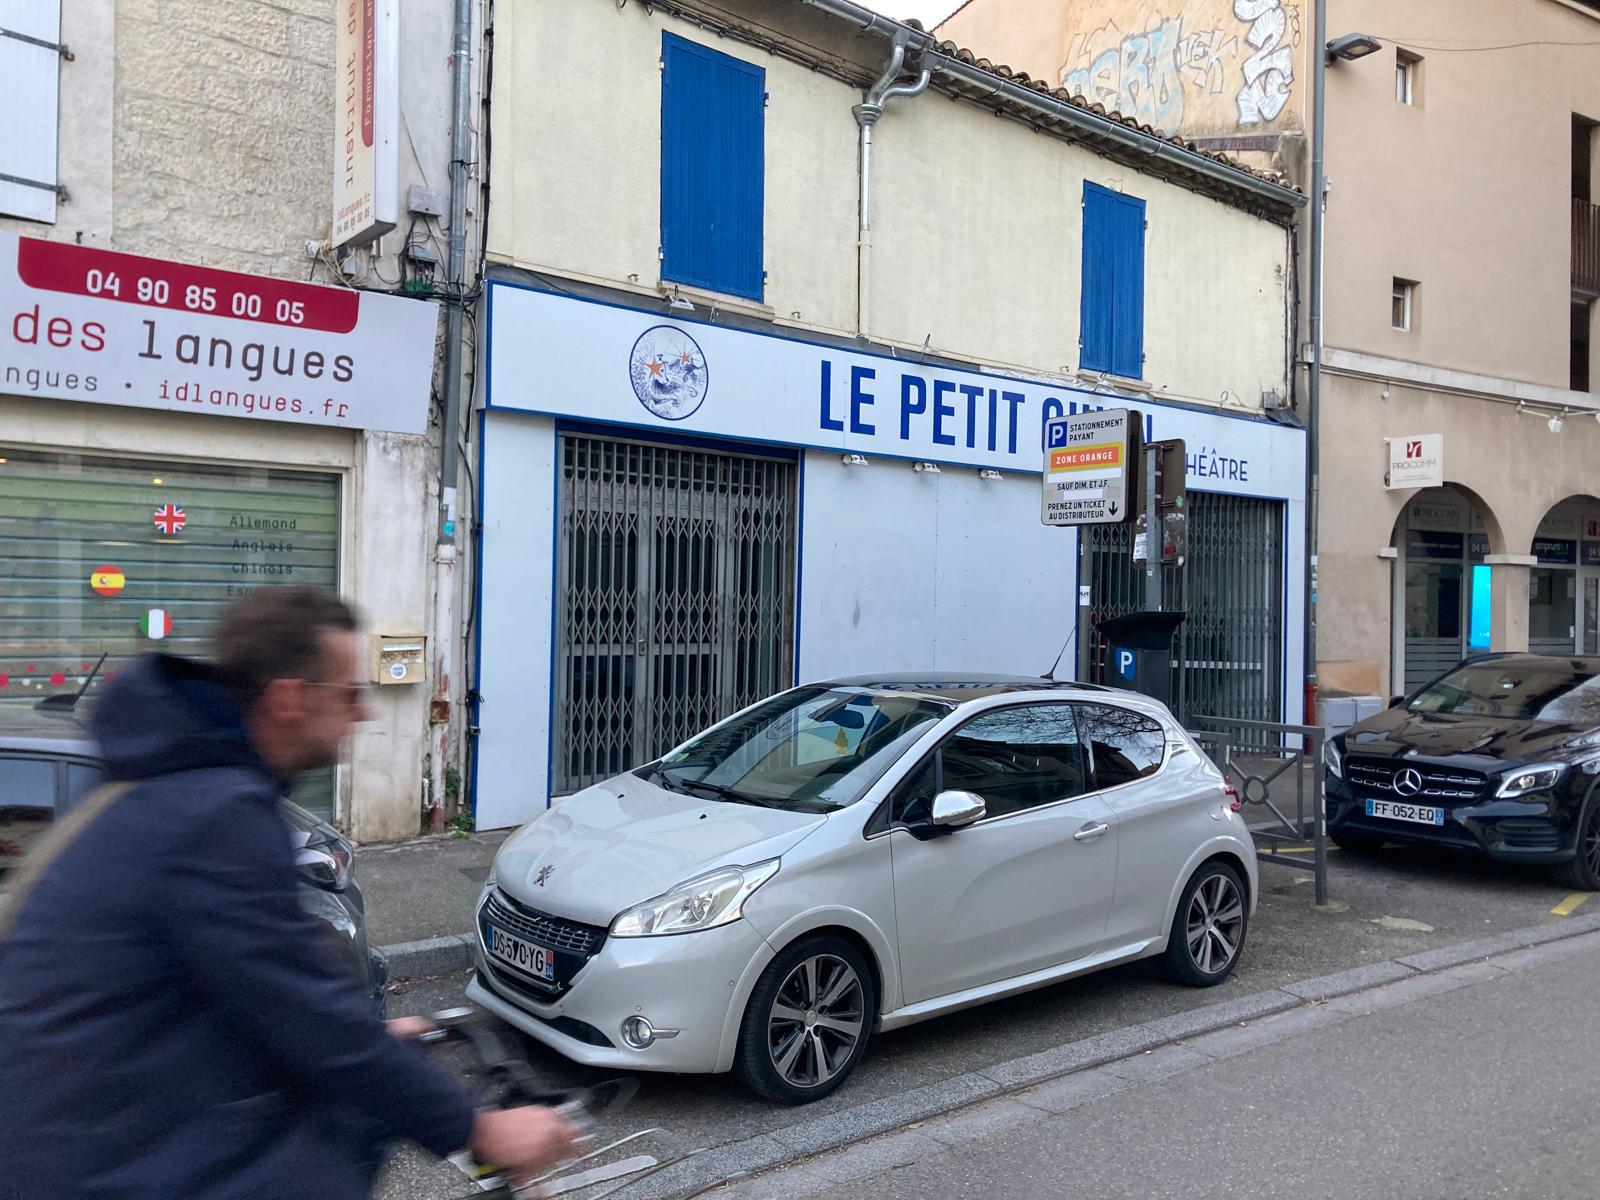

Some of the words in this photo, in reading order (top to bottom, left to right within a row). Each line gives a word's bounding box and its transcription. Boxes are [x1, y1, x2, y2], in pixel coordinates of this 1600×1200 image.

[345, 52, 356, 188] institut
[86, 268, 120, 297] 04
[137, 277, 169, 305] 90
[185, 285, 217, 312] 85
[232, 292, 262, 318] 00
[276, 299, 305, 324] 05
[12, 303, 106, 352] des
[138, 319, 355, 383] langues
[158, 380, 349, 418] idlangues.fr
[819, 359, 876, 436] LE
[900, 373, 1026, 454] PETIT
[1051, 425, 1064, 446] P
[1070, 418, 1123, 432] STATIONNEMENT
[1069, 432, 1094, 442] PAYANT
[1056, 454, 1077, 465] ZONE
[1080, 451, 1113, 462] ORANGE
[1185, 446, 1249, 482] HÉÂTRE
[1057, 482, 1073, 491] SAUF
[1089, 480, 1097, 488] ET
[1047, 501, 1072, 511] PRENEZ
[1073, 501, 1083, 510] UN
[1083, 500, 1106, 509] TICKET
[1049, 512, 1058, 520] AU
[1058, 510, 1104, 520] DISTRIBUTEUR
[229, 515, 297, 530] Allemand
[232, 539, 294, 554] Anglais
[232, 562, 293, 575] Chinois
[1120, 651, 1133, 674] P
[1374, 802, 1435, 822] FF-052-EQ
